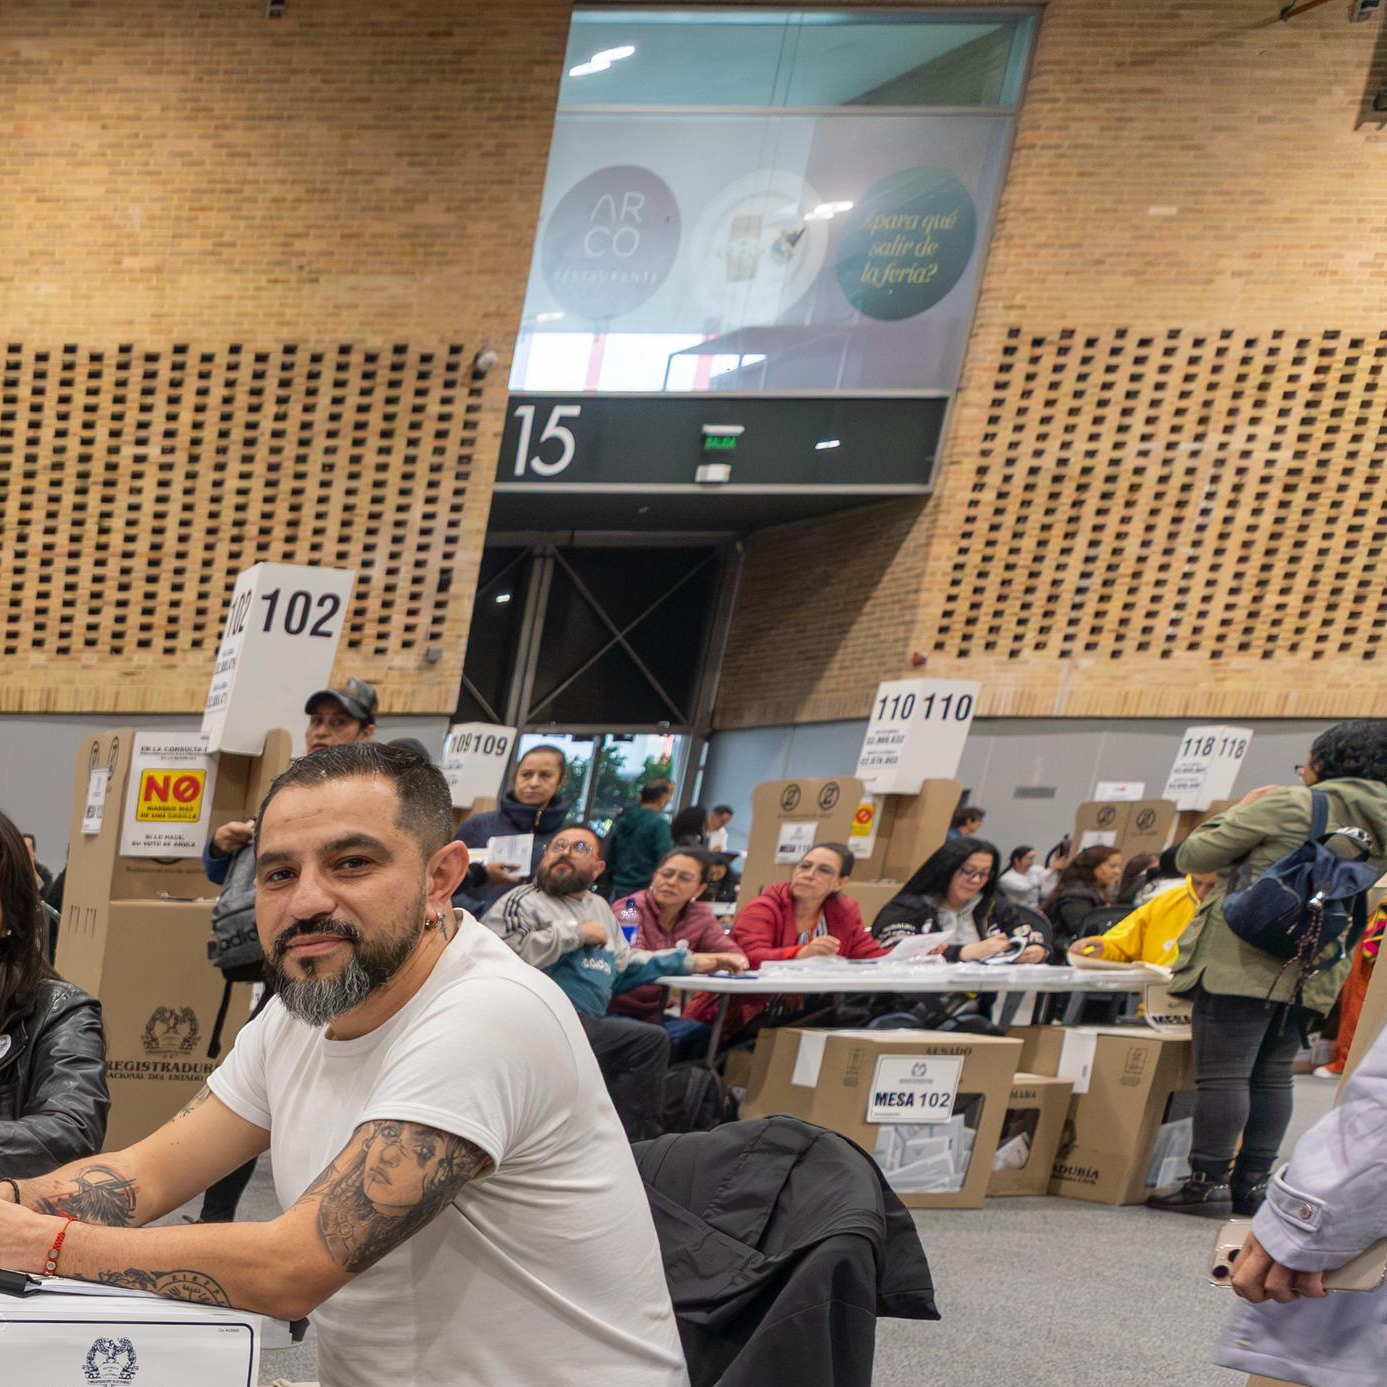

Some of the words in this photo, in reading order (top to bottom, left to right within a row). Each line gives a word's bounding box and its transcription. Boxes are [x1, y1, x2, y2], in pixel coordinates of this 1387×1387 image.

[582, 227, 640, 258] CO
[513, 405, 581, 476] 15
[227, 589, 253, 638] 102
[261, 587, 341, 638] 102
[878, 693, 917, 720] 110
[923, 692, 973, 721] 110
[451, 733, 473, 753] 109
[474, 734, 509, 756] 109
[1183, 736, 1216, 757] 118
[1219, 736, 1247, 759] 118
[144, 775, 201, 803] NO
[874, 1092, 915, 1107] MESA
[920, 1092, 952, 1108] 102
